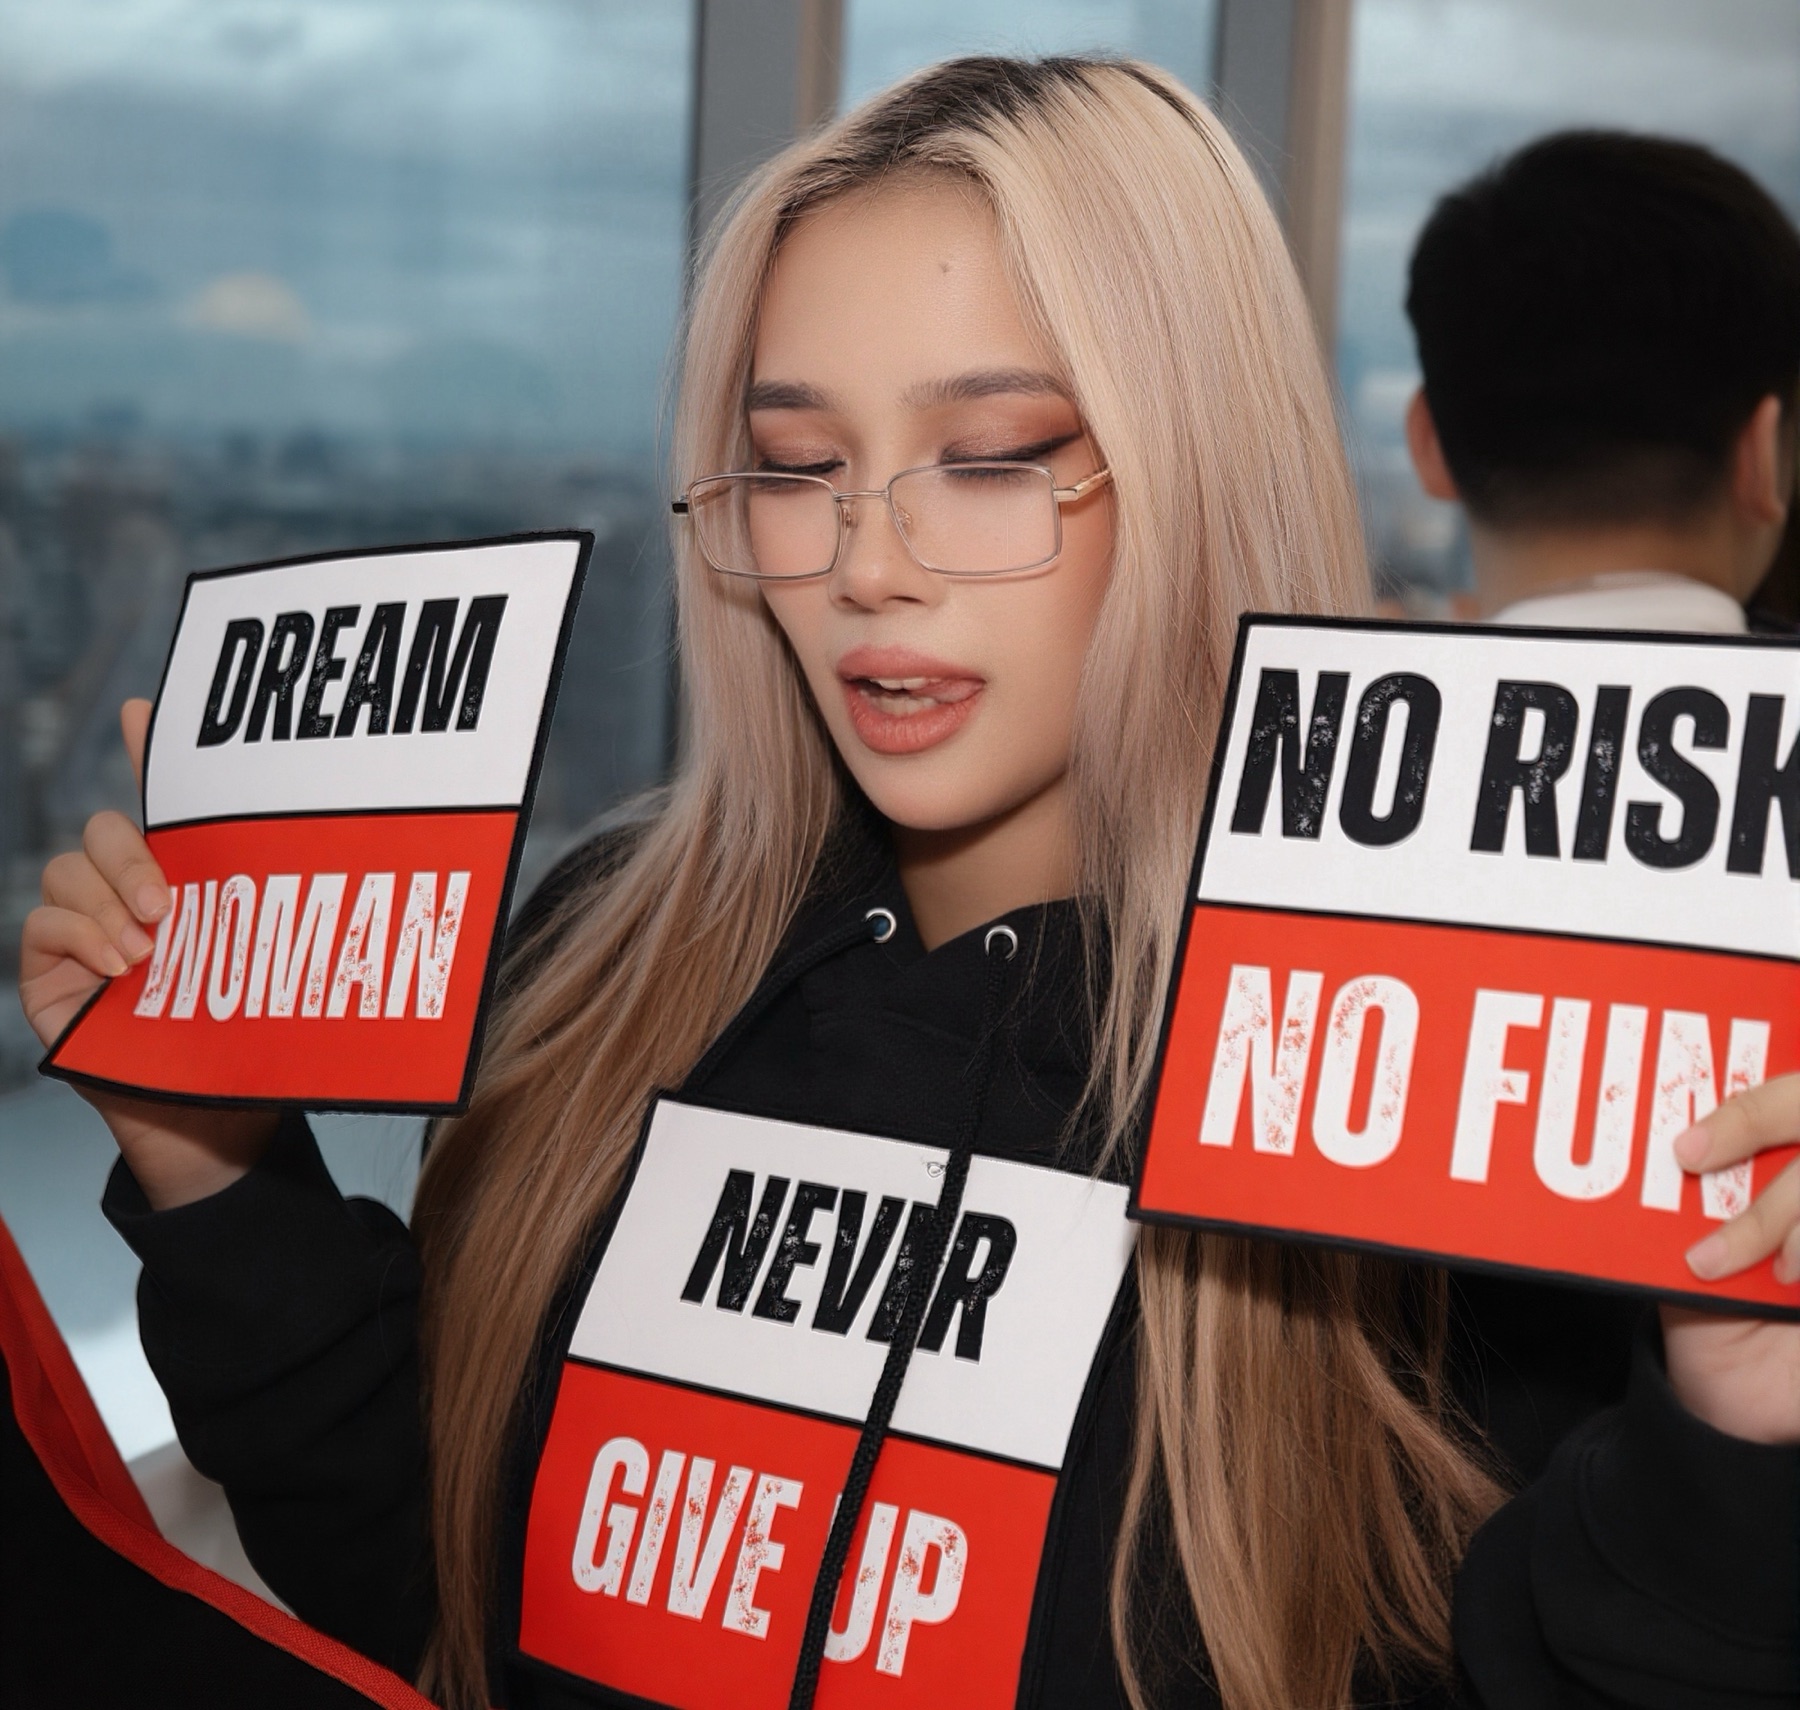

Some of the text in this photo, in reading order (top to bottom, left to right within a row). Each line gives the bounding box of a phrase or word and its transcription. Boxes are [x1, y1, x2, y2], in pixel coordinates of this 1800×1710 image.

[196, 594, 509, 749] DREAM
[1229, 667, 1800, 881] NO RISK
[133, 871, 471, 1022] WOMAN
[1199, 964, 1771, 1221] NO FUN
[571, 1436, 968, 1678] GIVE UP
